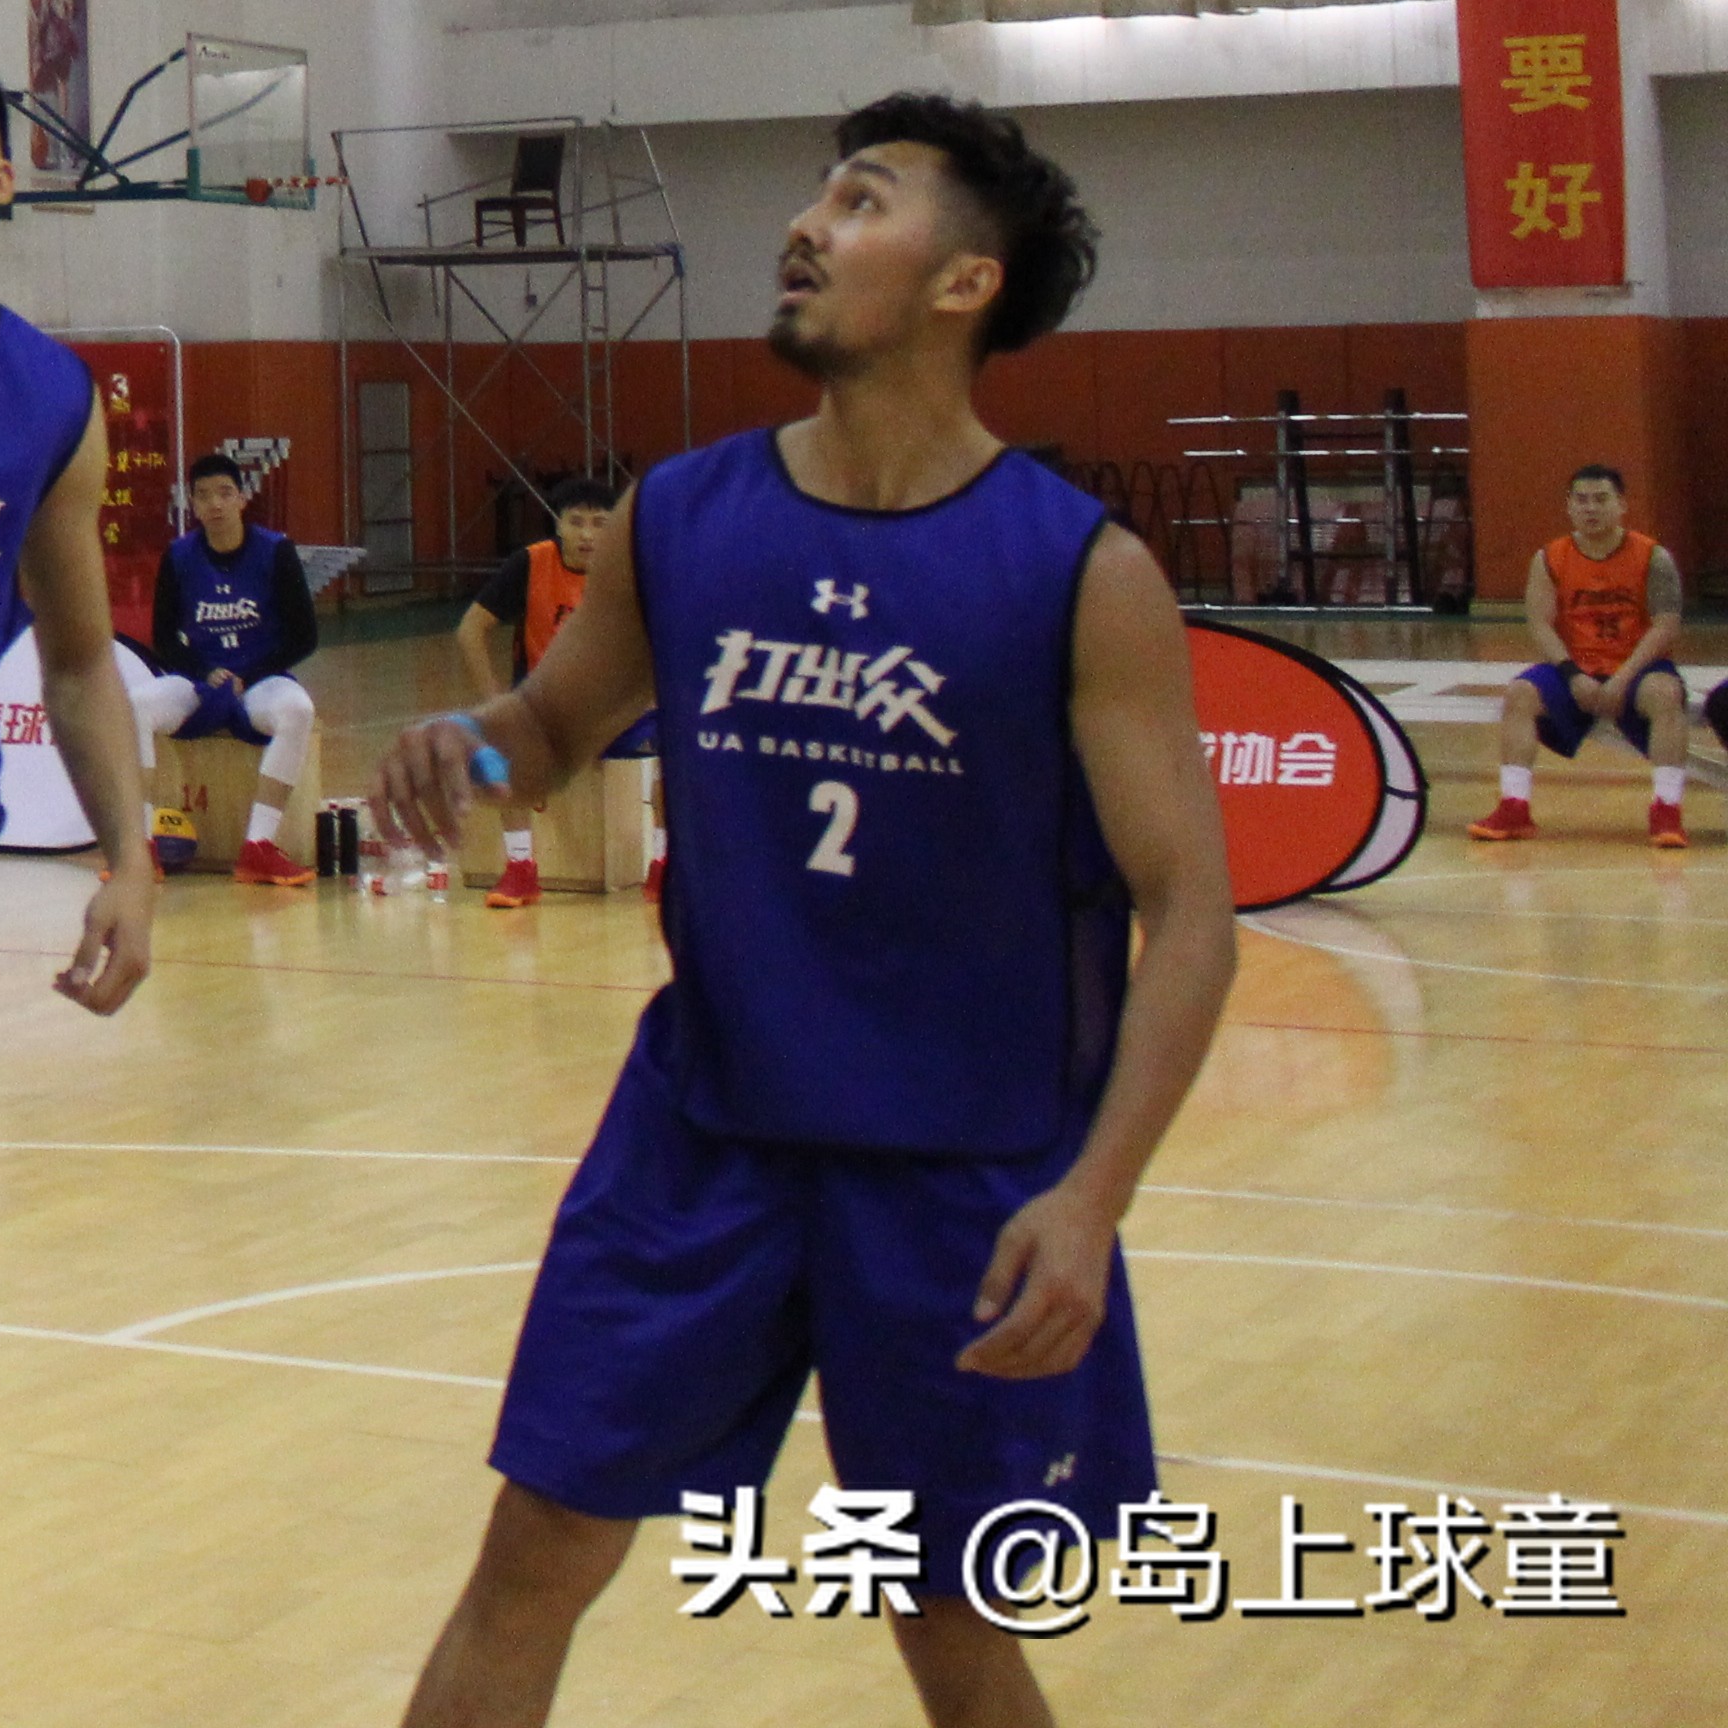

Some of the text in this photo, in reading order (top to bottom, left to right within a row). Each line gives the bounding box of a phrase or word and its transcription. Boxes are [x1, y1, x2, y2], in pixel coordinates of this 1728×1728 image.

[697, 731, 966, 775] UA BASKETBALL
[806, 780, 860, 877] 2
